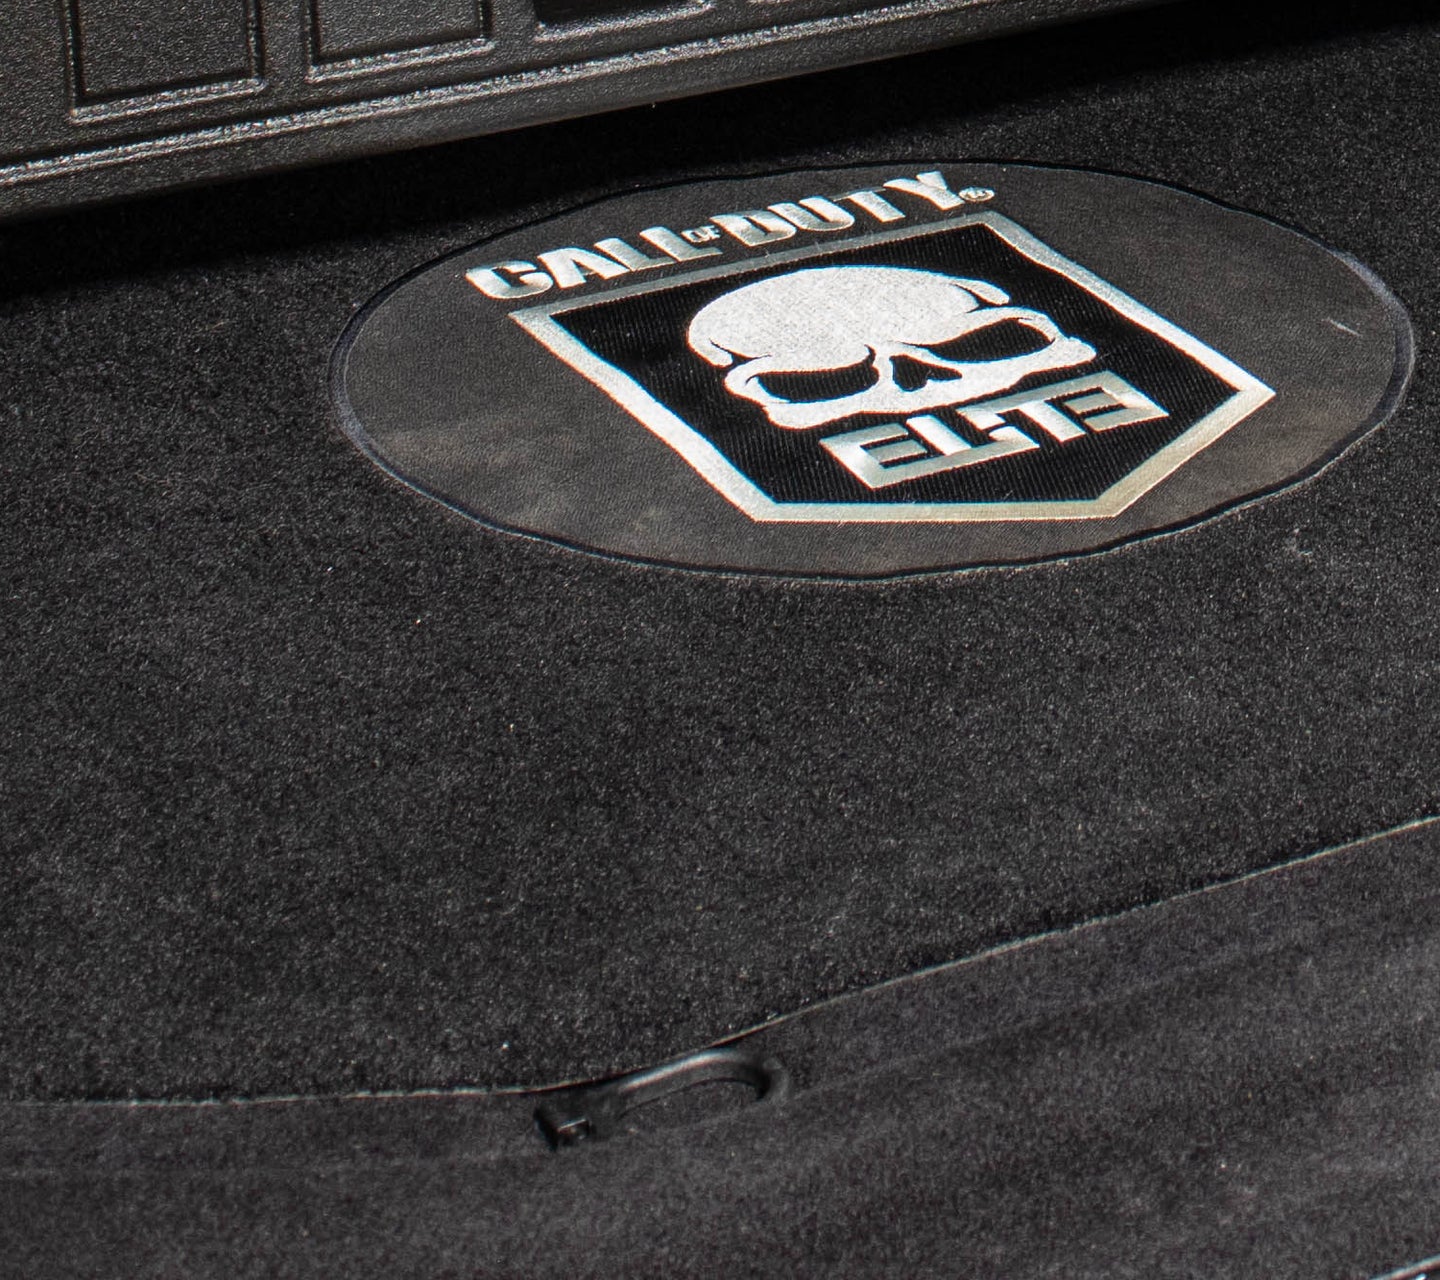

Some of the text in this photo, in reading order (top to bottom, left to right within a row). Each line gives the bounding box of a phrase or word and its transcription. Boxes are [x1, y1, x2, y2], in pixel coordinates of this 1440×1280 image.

[465, 226, 723, 300] CALL
[681, 224, 723, 244] OF
[819, 369, 1169, 490] ELITE
